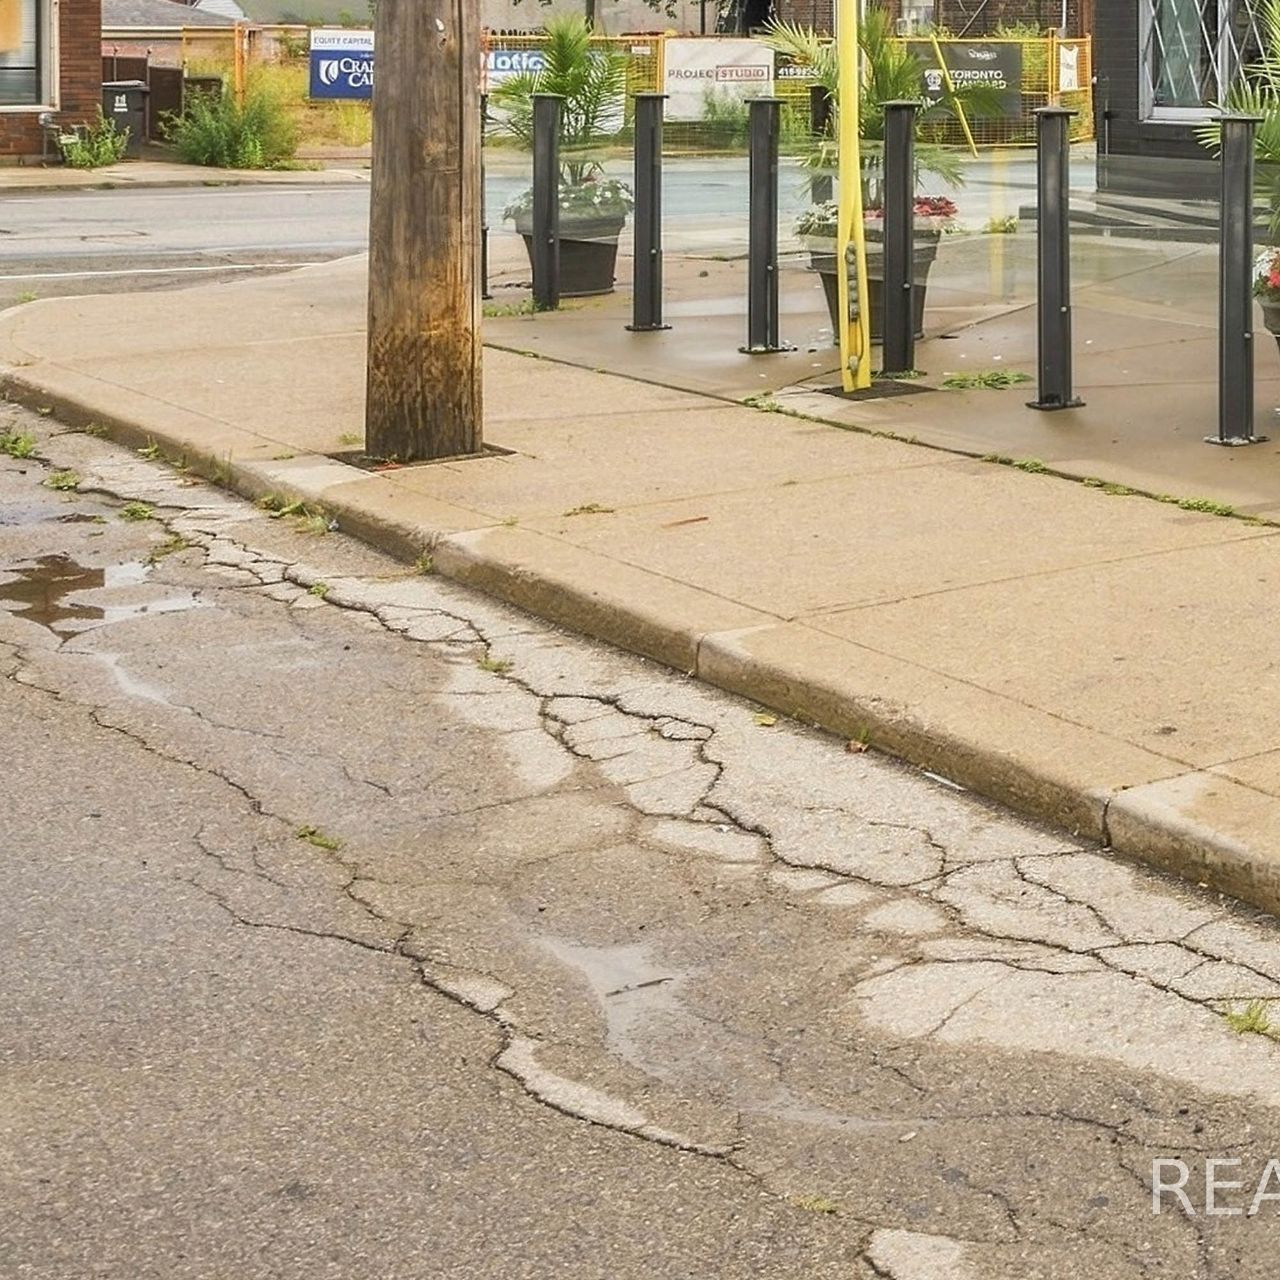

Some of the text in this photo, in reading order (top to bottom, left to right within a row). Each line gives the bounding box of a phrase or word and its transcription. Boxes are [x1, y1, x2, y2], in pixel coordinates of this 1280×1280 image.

[480, 51, 543, 70] Notic
[721, 68, 765, 79] STUDIO
[949, 70, 1003, 79] TORONTO
